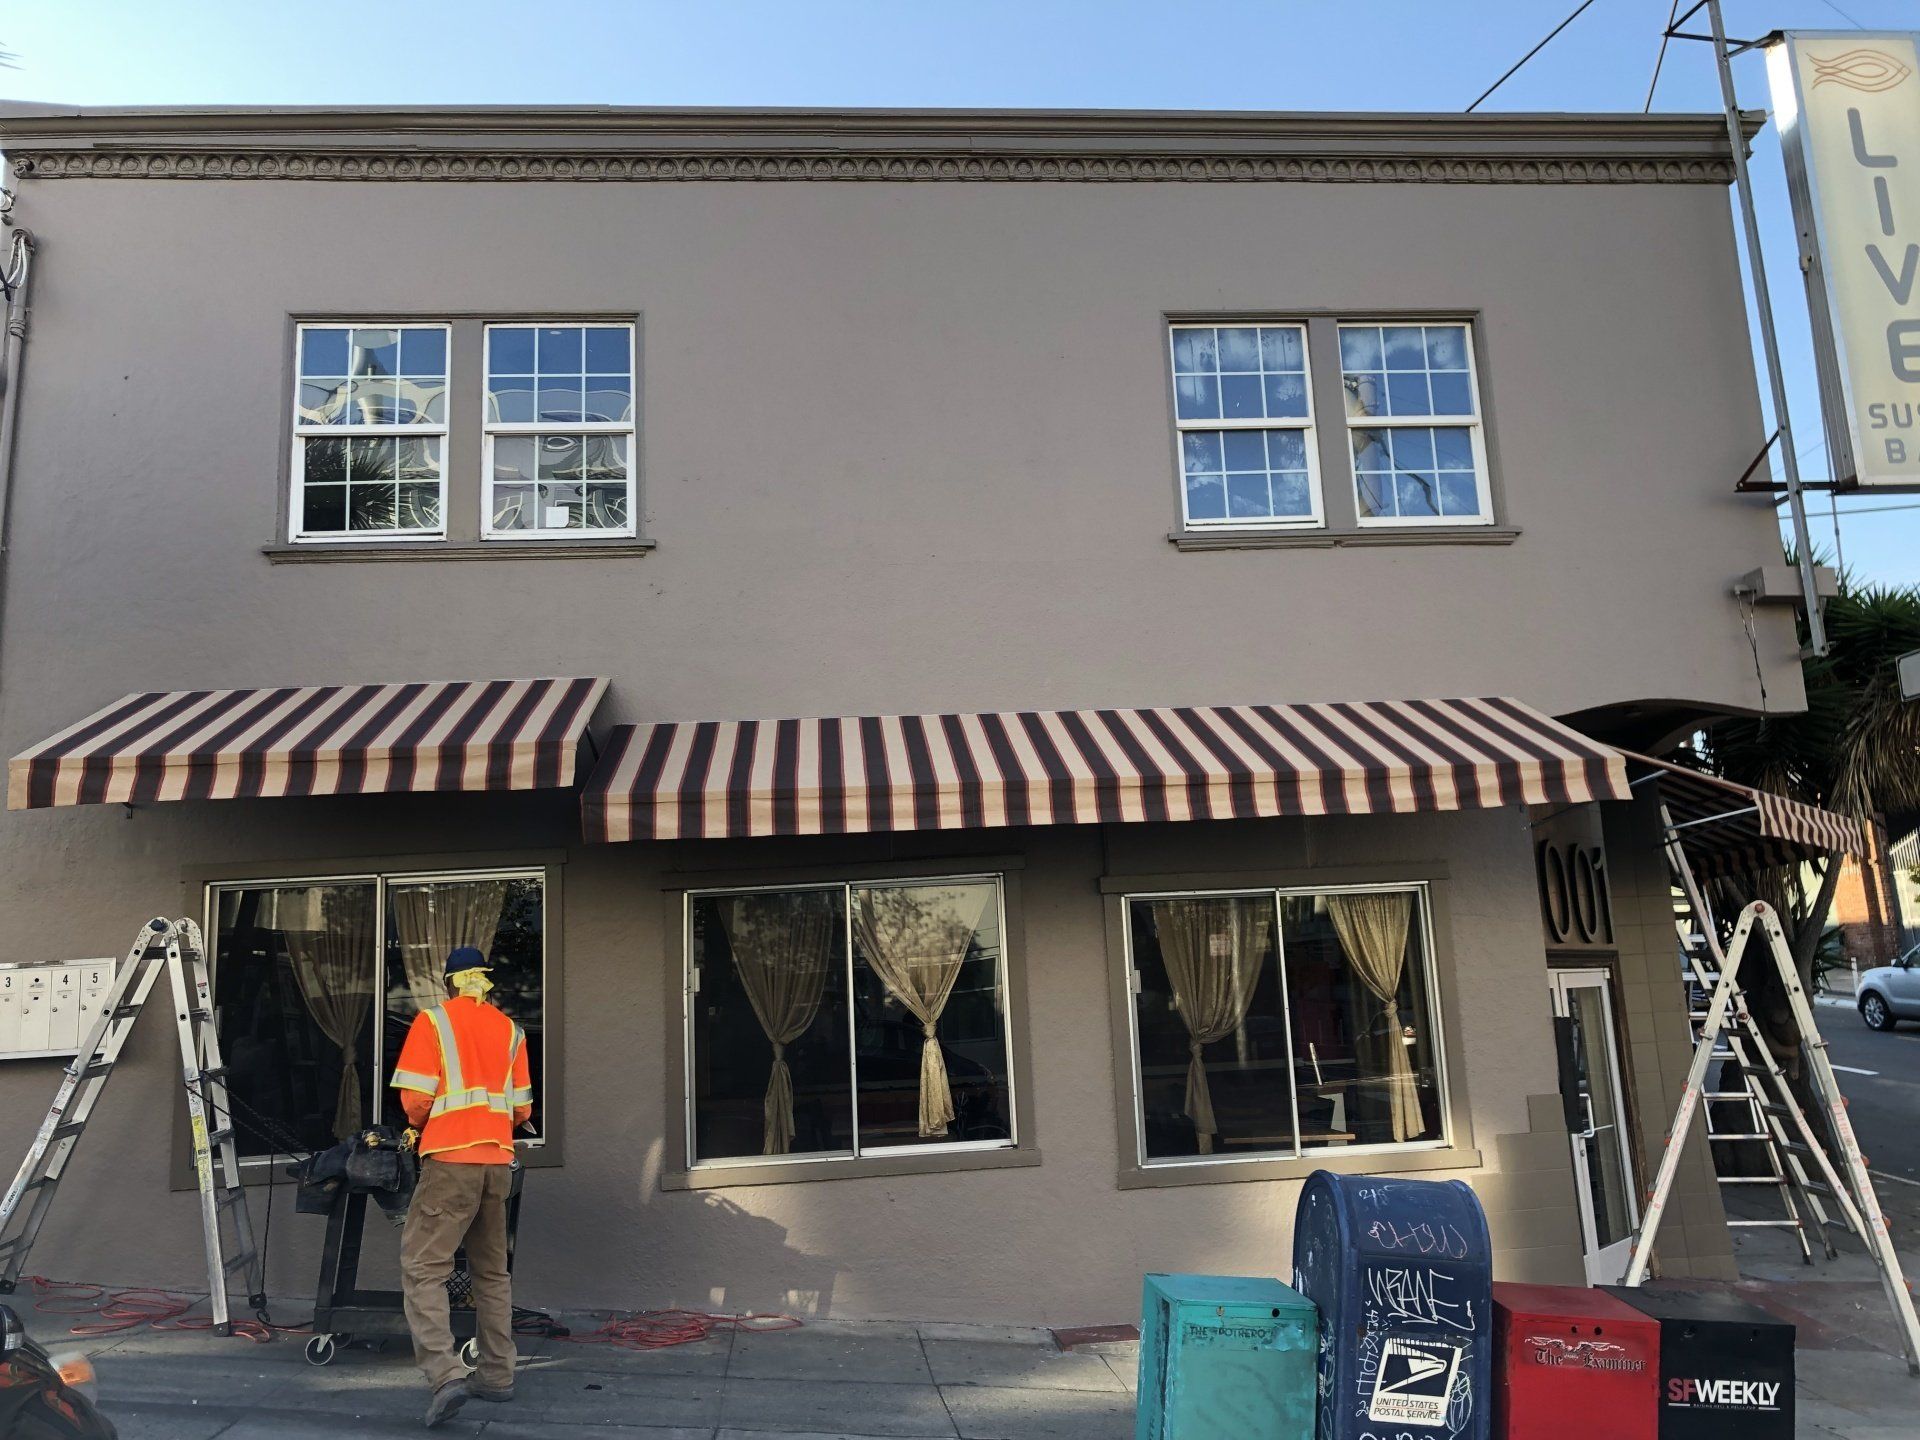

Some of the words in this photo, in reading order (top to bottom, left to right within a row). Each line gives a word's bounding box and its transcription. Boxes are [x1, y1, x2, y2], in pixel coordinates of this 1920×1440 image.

[1868, 402, 1920, 429] SU
[1884, 437, 1920, 464] B
[5, 976, 11, 988] 3
[62, 974, 69, 985] 4
[92, 972, 99, 984] 5
[1190, 1326, 1208, 1336] THE
[1534, 1347, 1563, 1366] The
[1583, 1350, 1646, 1371] Examiner
[1376, 1398, 1408, 1407] UNITED
[1410, 1400, 1439, 1409] STATES
[1374, 1408, 1405, 1417] POSTAL
[1407, 1410, 1442, 1420] SERVICE
